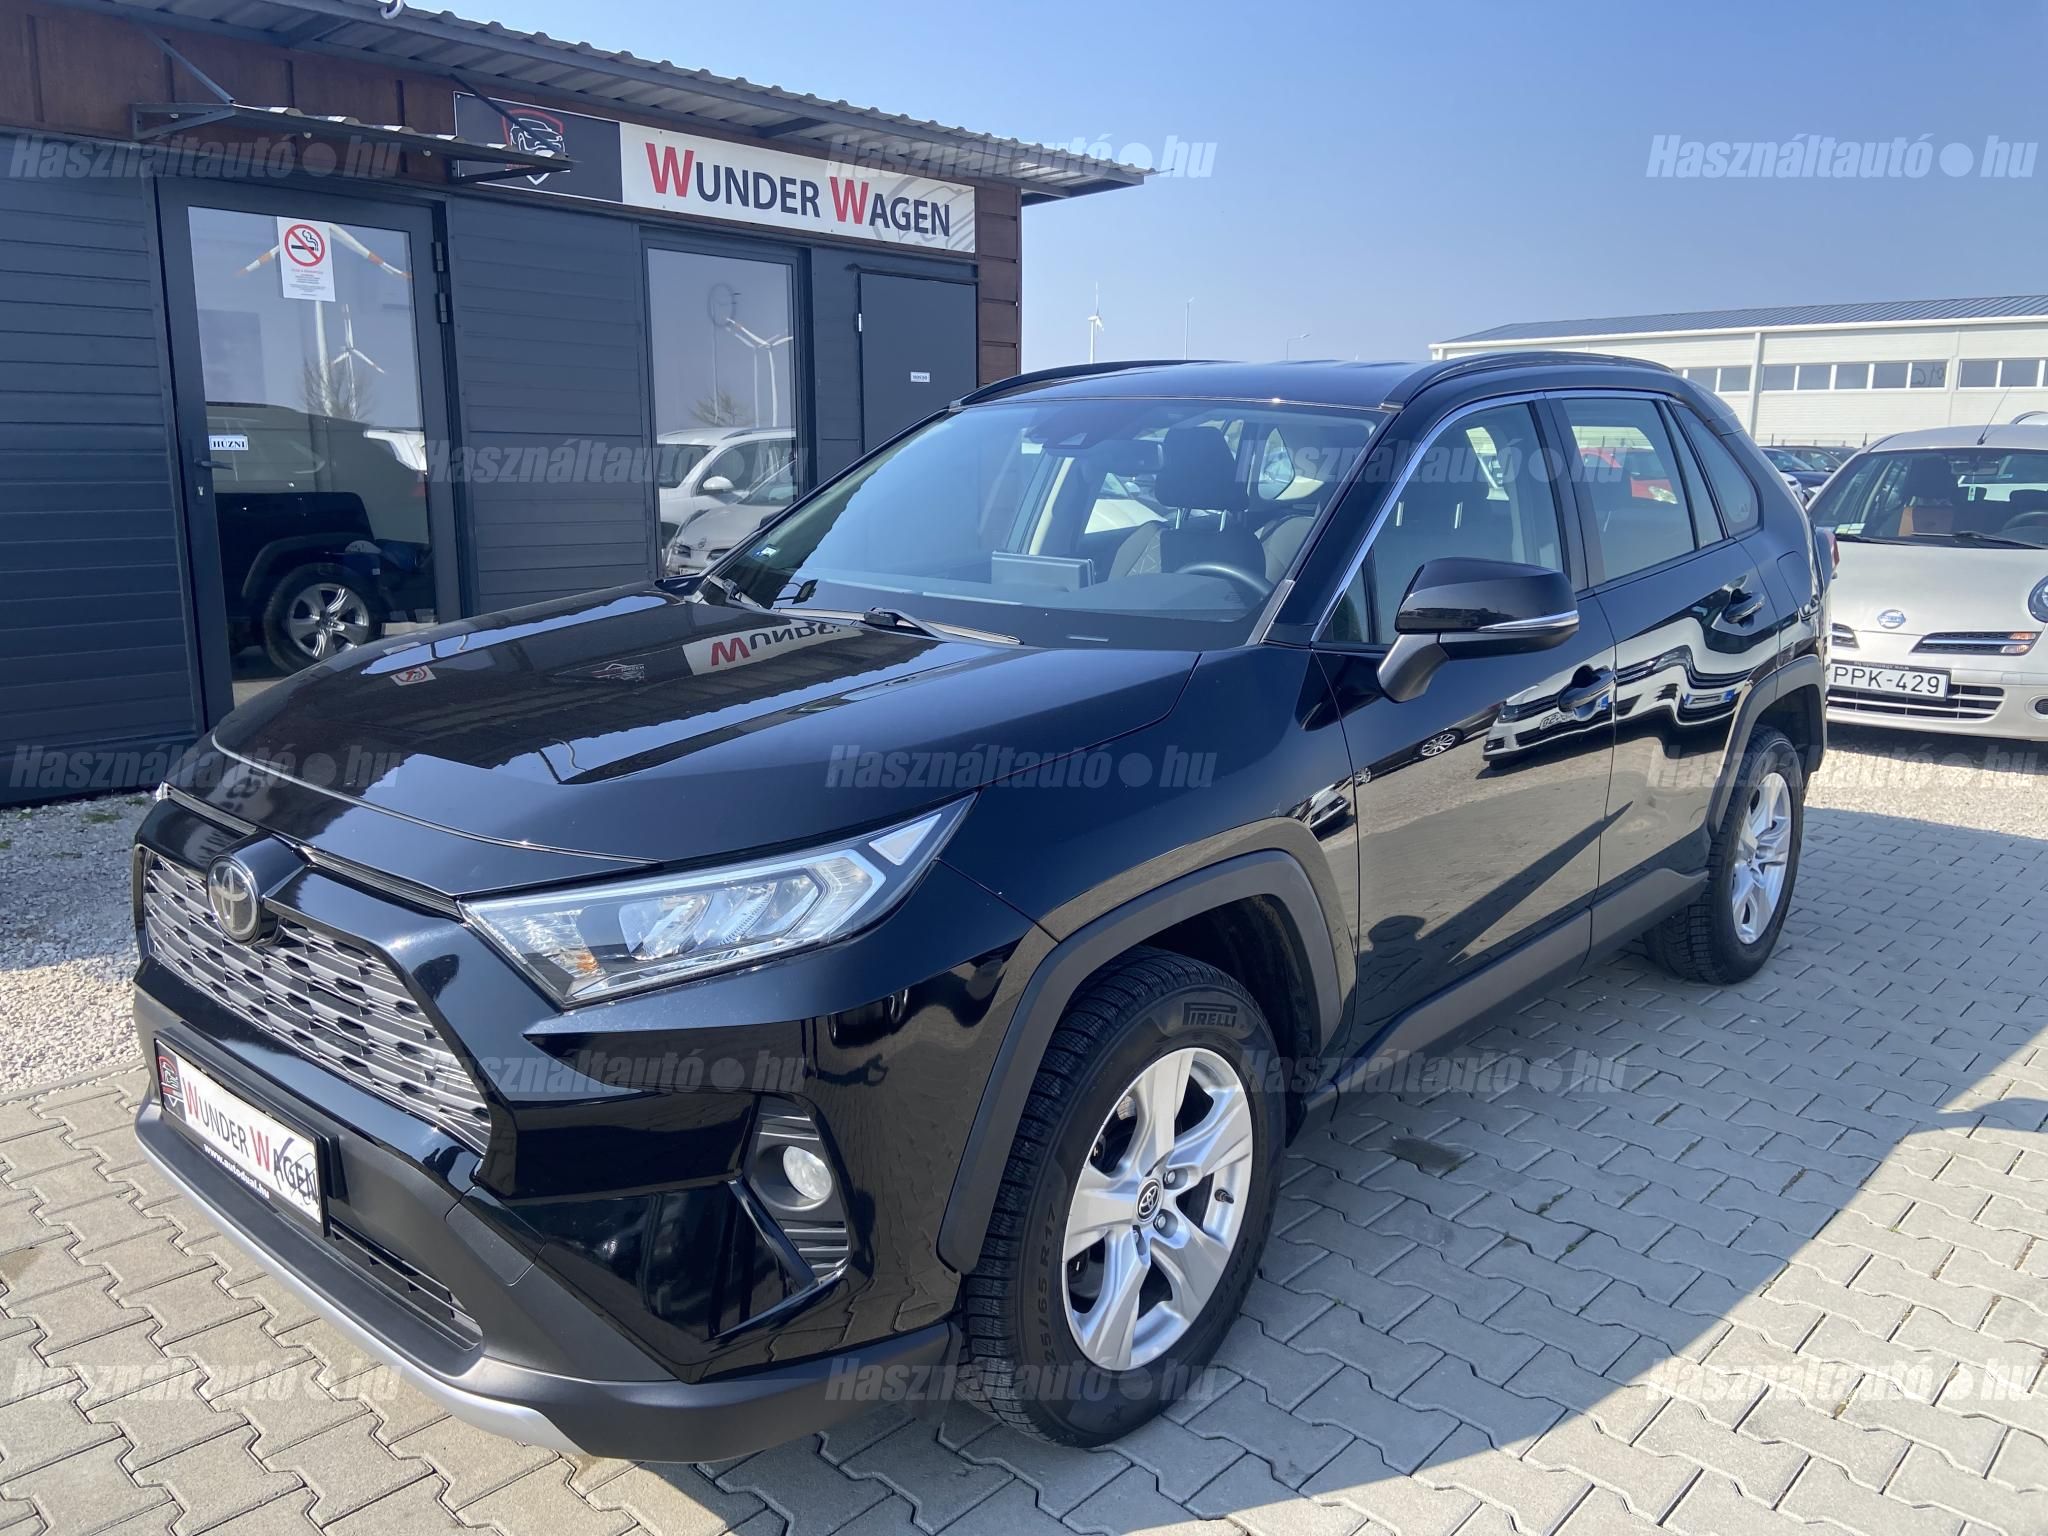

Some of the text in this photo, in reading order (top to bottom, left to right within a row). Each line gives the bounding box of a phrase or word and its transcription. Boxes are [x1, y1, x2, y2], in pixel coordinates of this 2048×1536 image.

[645, 142, 951, 238] WUNDER WAGEN
[1833, 666, 1941, 695] PPK-429
[1182, 1002, 1238, 1028] PIRELLI
[182, 1076, 250, 1159] WUNDER
[203, 1143, 270, 1200] www.autodual.hu
